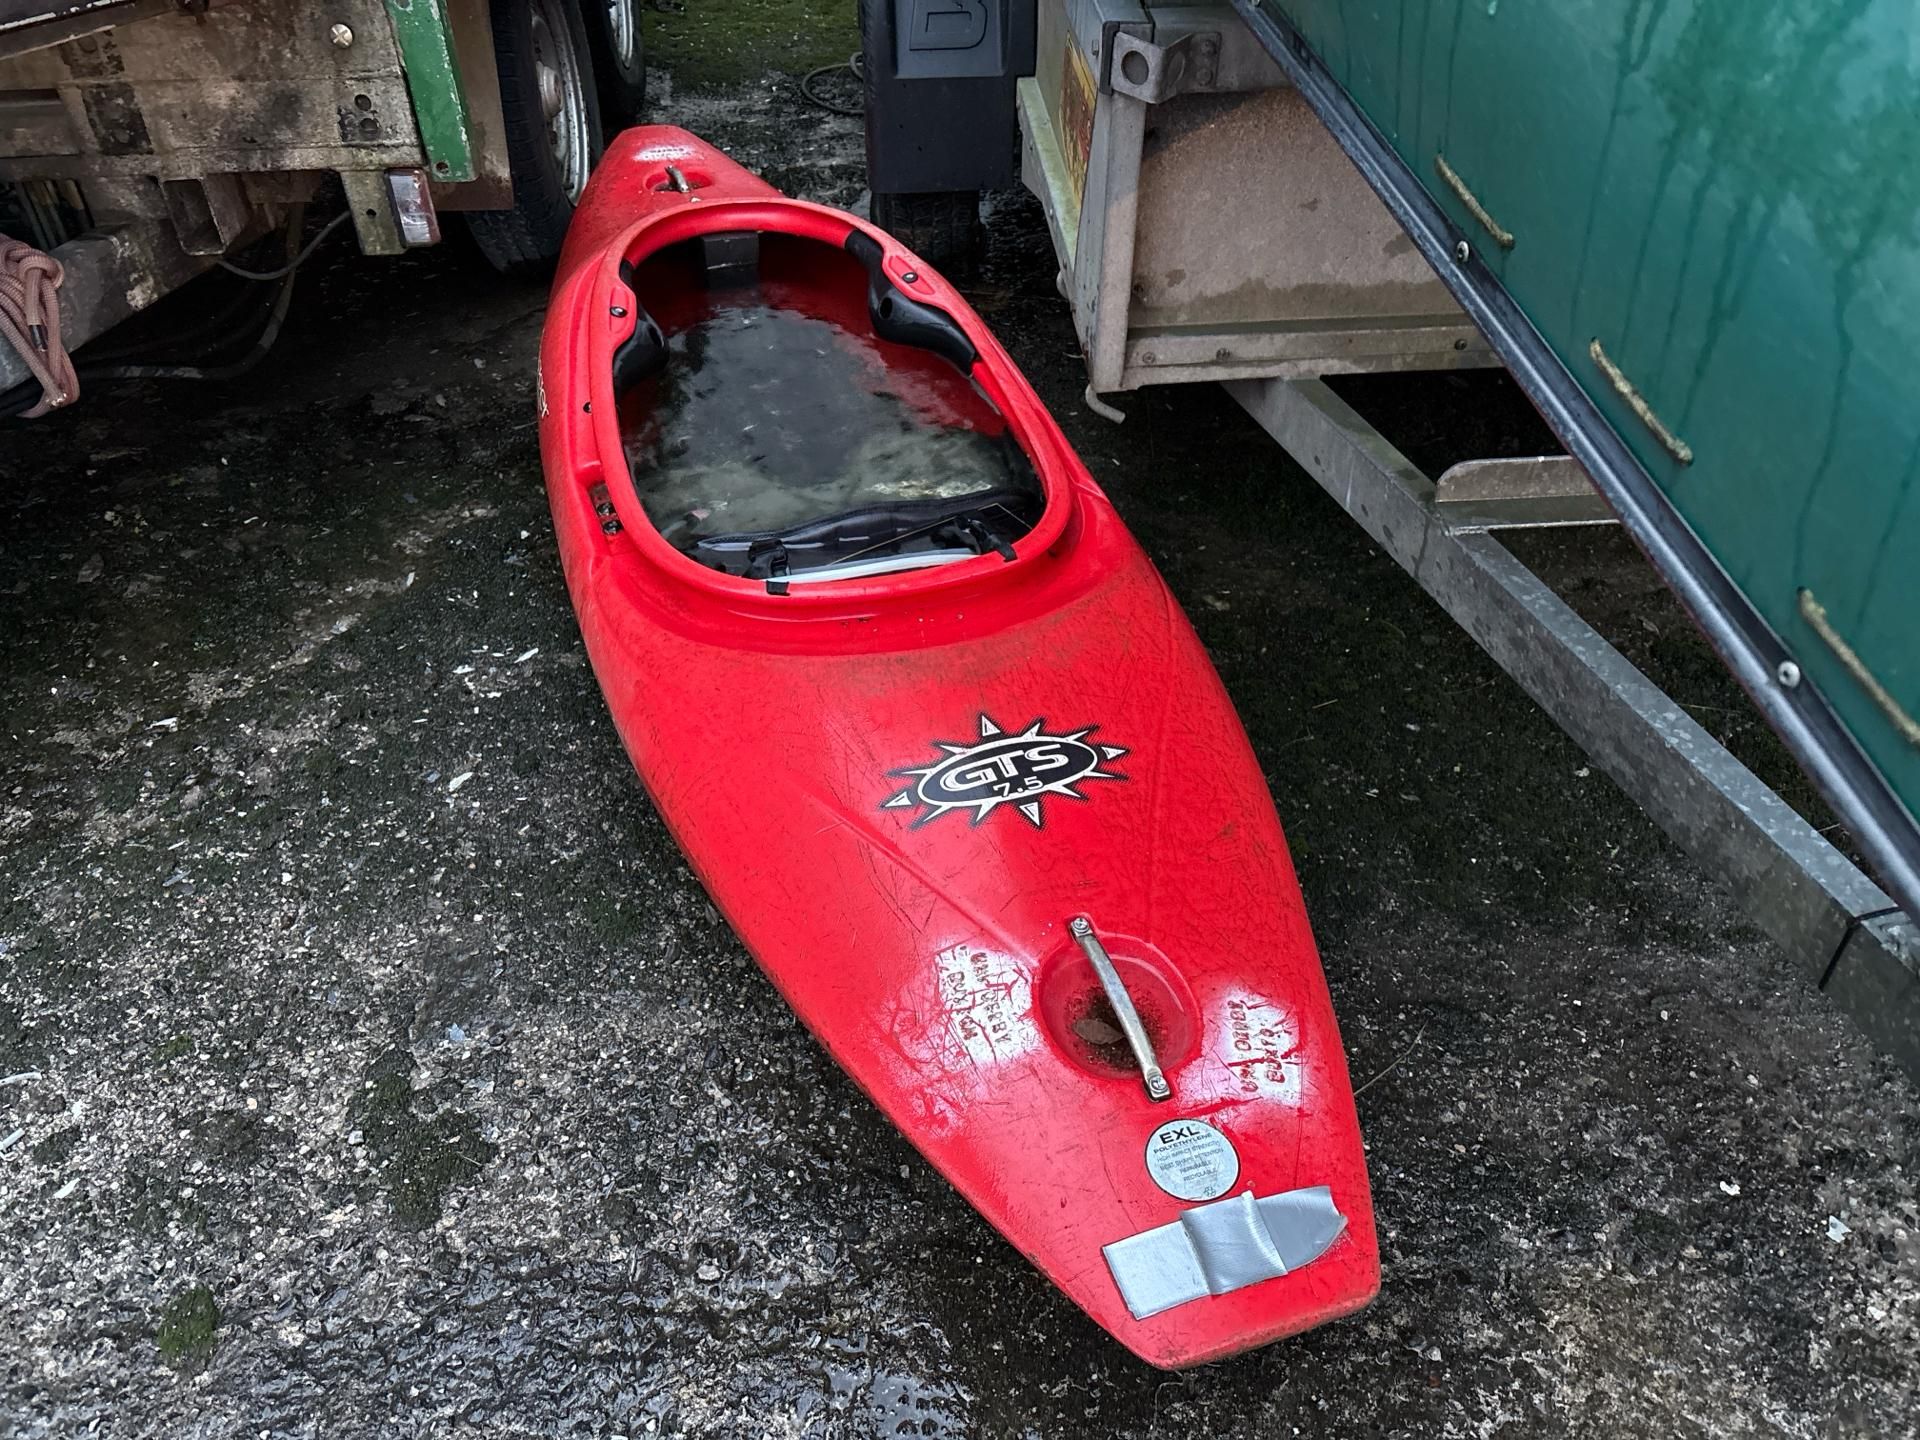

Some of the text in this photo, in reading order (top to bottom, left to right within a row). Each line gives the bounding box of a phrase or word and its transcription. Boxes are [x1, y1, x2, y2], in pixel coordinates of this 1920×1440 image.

[939, 744, 1070, 792] GTS
[993, 776, 1044, 798] 7.5
[1153, 1132, 1213, 1155] POLYETHYLENE
[1159, 1126, 1201, 1145] EXL
[1183, 1167, 1217, 1181] RECYCLABLE
